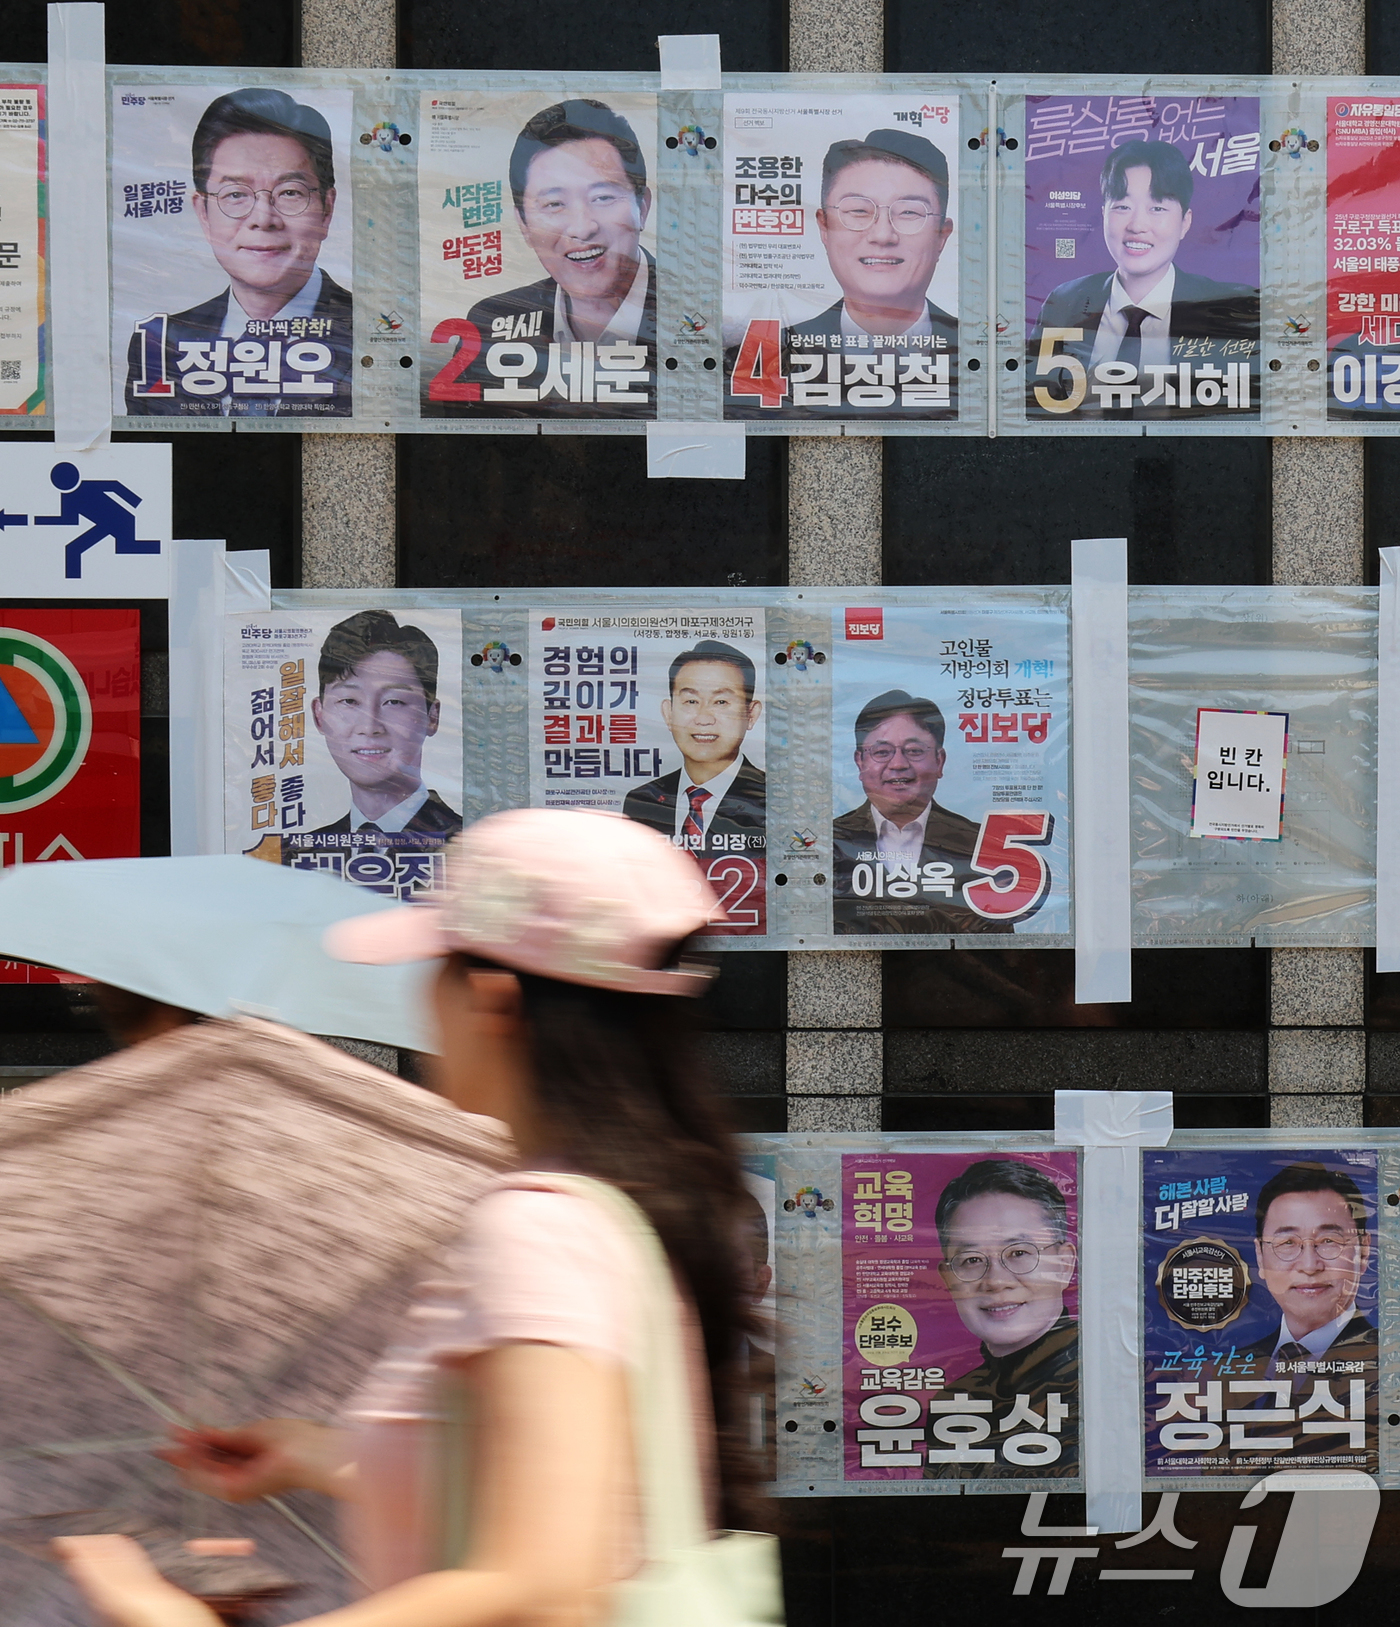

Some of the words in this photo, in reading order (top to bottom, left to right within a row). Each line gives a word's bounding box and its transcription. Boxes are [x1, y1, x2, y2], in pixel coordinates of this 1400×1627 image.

[893, 104, 950, 127] 개혁신당
[734, 155, 803, 179] 조용한
[1189, 132, 1260, 177] 서울
[123, 196, 184, 219] 서울시장
[441, 180, 502, 210] 시작된
[735, 183, 803, 207] 다수의
[1049, 191, 1081, 200] 여성의당
[461, 200, 503, 229] 변화
[734, 209, 802, 234] 변호인
[1333, 220, 1375, 235] 구로구
[441, 229, 502, 261] 압도적
[1333, 237, 1391, 251] 32.03%
[461, 252, 503, 280] 완성
[1333, 256, 1371, 273] 서울의
[1338, 293, 1375, 312] 강한
[247, 320, 289, 337] 하나씩
[290, 318, 333, 338] 착착!
[490, 310, 543, 341] 역시!
[790, 334, 827, 349] 당신의
[829, 334, 842, 349] 한
[845, 334, 869, 349] 표를
[872, 334, 908, 349] 끝까지
[911, 334, 948, 349] 지키는
[1172, 336, 1215, 358] 유일한
[1219, 338, 1256, 360] 선택
[133, 313, 175, 398] 1
[176, 340, 334, 396] 정원오
[428, 318, 481, 402] 2
[730, 318, 788, 408] 4
[483, 340, 650, 403] 오세훈
[790, 353, 950, 408] 김정철
[1033, 327, 1087, 414] 5
[1091, 361, 1250, 408] 유지혜
[241, 628, 272, 639] 민주당
[558, 618, 589, 627] 국민의힘
[592, 617, 678, 628] 서울시의회의원선거
[680, 617, 754, 628] 마포구제3선거구
[633, 629, 663, 639] (서강동,
[665, 629, 691, 639] 합정동,
[693, 629, 720, 639] 서교동,
[722, 629, 755, 639] 망원1동)
[848, 623, 881, 636] 진보당
[543, 645, 638, 676] 경험의
[939, 638, 993, 658] 고인물
[940, 659, 1009, 679] 지방의회
[1014, 659, 1054, 679] 개혁!
[543, 680, 639, 710] 깊이가
[956, 687, 1053, 709] 정당투표는
[250, 687, 275, 769] 젊어서
[543, 714, 638, 744] 결과를
[957, 712, 1052, 745] 진보당
[544, 748, 662, 778] 만듭니다
[1219, 746, 1237, 766] 빈
[1244, 748, 1263, 768] 칸
[1207, 770, 1271, 793] 입니다.
[250, 773, 278, 831] 좋다
[280, 774, 306, 830] 좋다
[290, 834, 377, 848] 서울시의원후보
[711, 833, 767, 851] 의장(전)
[962, 809, 1053, 922] 5
[706, 854, 759, 926] 2
[852, 861, 955, 898] 이상옥
[853, 1170, 914, 1200] 교육
[1159, 1181, 1192, 1201] 해본
[1193, 1176, 1229, 1196] 사람,
[853, 1202, 913, 1232] 혁명
[1155, 1202, 1180, 1231] 더
[1181, 1197, 1215, 1219] 잘할
[1215, 1193, 1249, 1213] 사람
[854, 1234, 868, 1243] 안전
[893, 1234, 914, 1243] 사교육
[1172, 1267, 1233, 1283] 민주진보
[1172, 1283, 1234, 1299] 단일후보
[870, 1315, 902, 1332] 보수
[859, 1334, 913, 1349] 단일후보
[1154, 1345, 1257, 1379] 교육감은
[1275, 1361, 1286, 1373] 現
[1287, 1361, 1365, 1374] 서울특별시교육감
[860, 1367, 945, 1391] 교육감은
[1155, 1379, 1366, 1452] 정근식
[856, 1392, 1069, 1468] 윤호상
[1218, 1457, 1231, 1465] 교수
[1354, 1455, 1367, 1463] 위원
